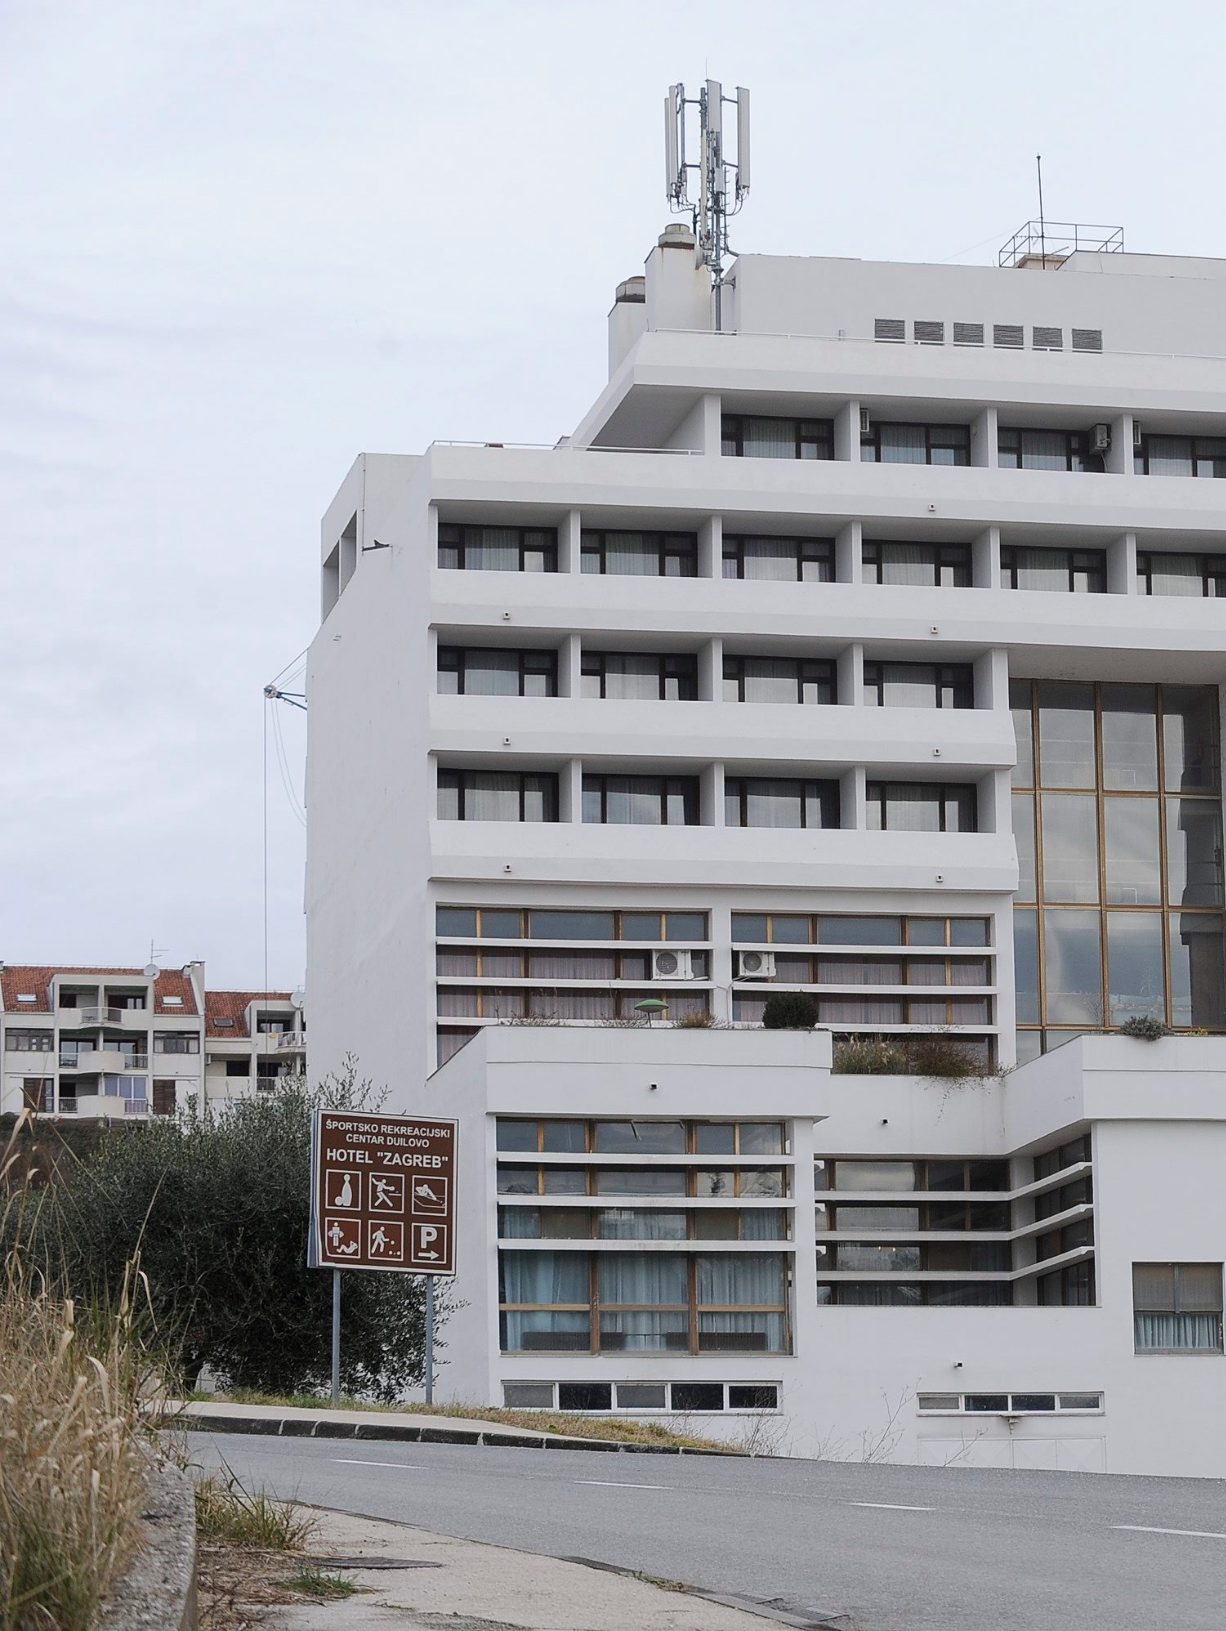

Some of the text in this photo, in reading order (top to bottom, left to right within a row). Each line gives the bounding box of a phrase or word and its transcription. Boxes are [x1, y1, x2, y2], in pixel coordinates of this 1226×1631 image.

[325, 1119, 451, 1138] ŠPORTSKO REKREACIJSKI
[346, 1133, 430, 1148] CENTAR DUILOVO
[326, 1148, 449, 1168] HOTEL "ZAGREB"
[421, 1226, 438, 1249] P
